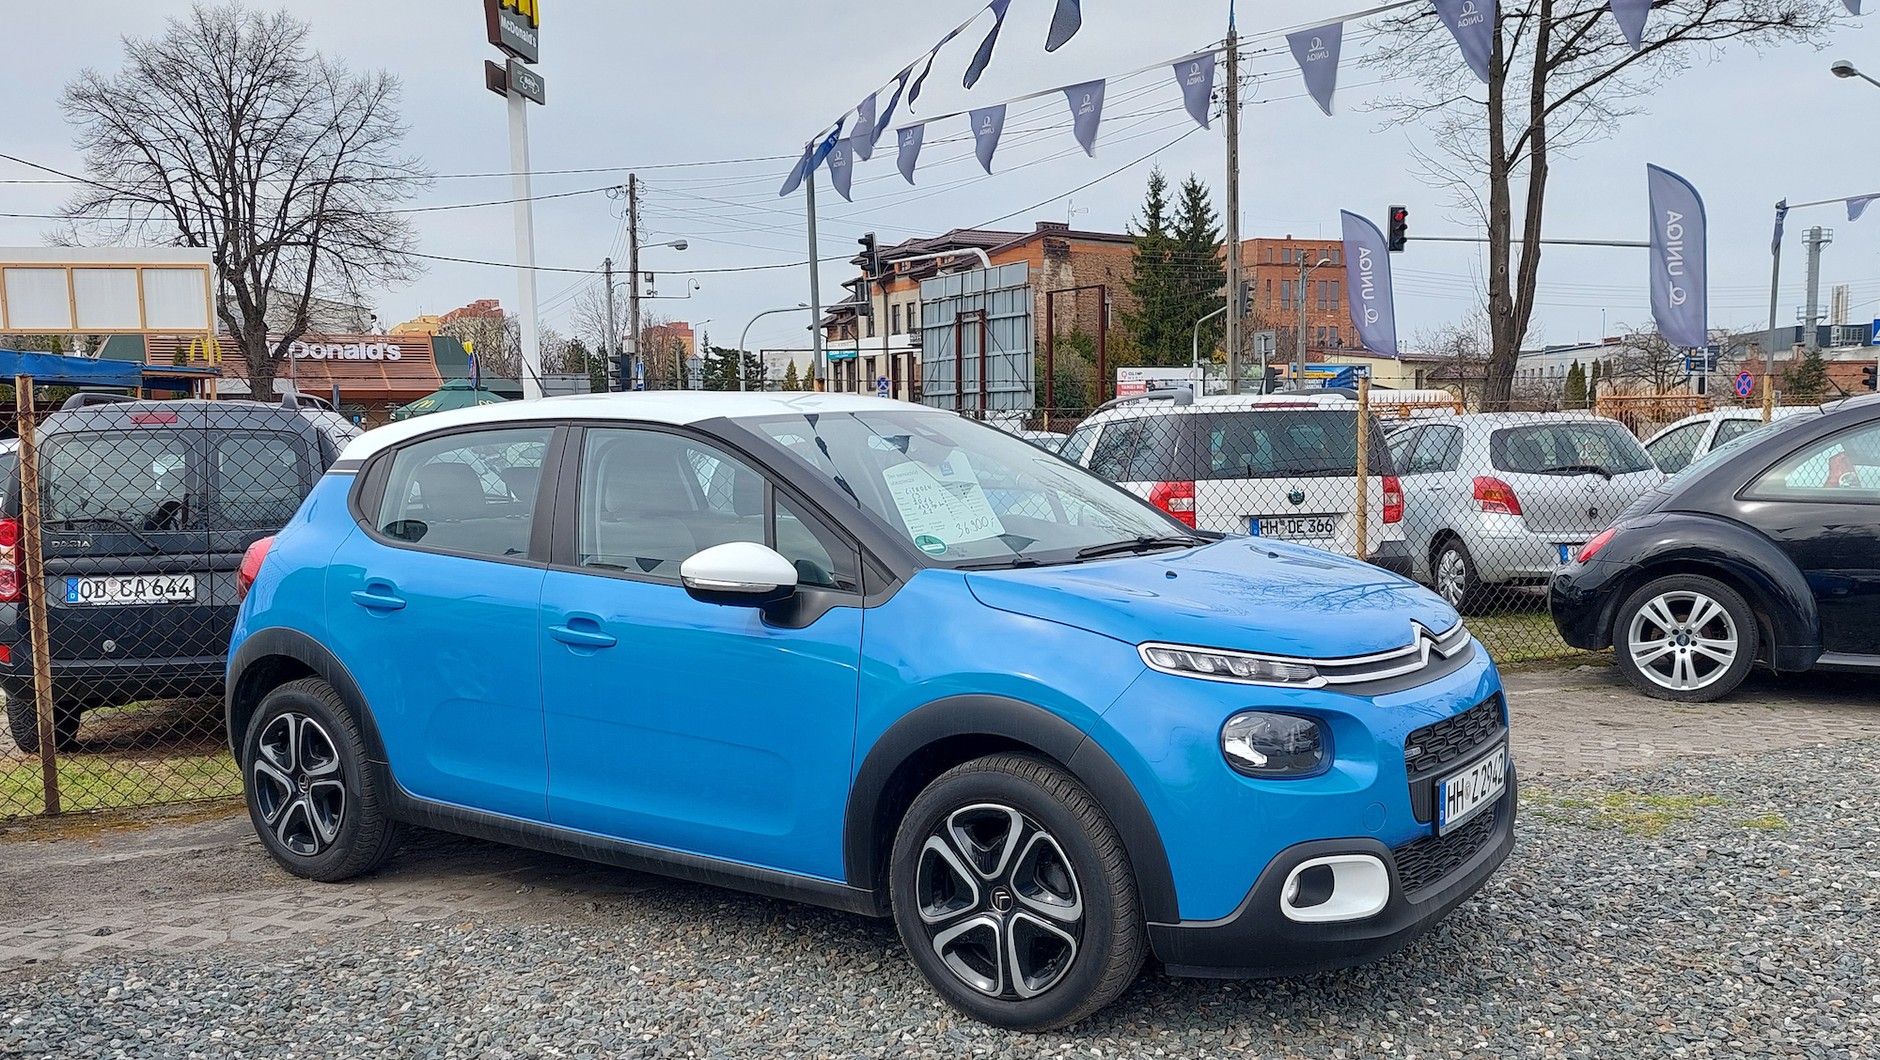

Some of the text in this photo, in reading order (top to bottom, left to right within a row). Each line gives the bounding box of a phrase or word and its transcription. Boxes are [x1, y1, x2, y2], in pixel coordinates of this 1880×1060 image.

[501, 15, 537, 48] McDonald's
[266, 341, 402, 361] Donald's
[1260, 519, 1333, 534] HH DE 366
[80, 580, 106, 599] OD
[120, 579, 147, 597] CA
[152, 578, 190, 597] 644
[1447, 778, 1464, 819] HH
[1472, 769, 1479, 804] Z
[1480, 753, 1503, 798] 2942
